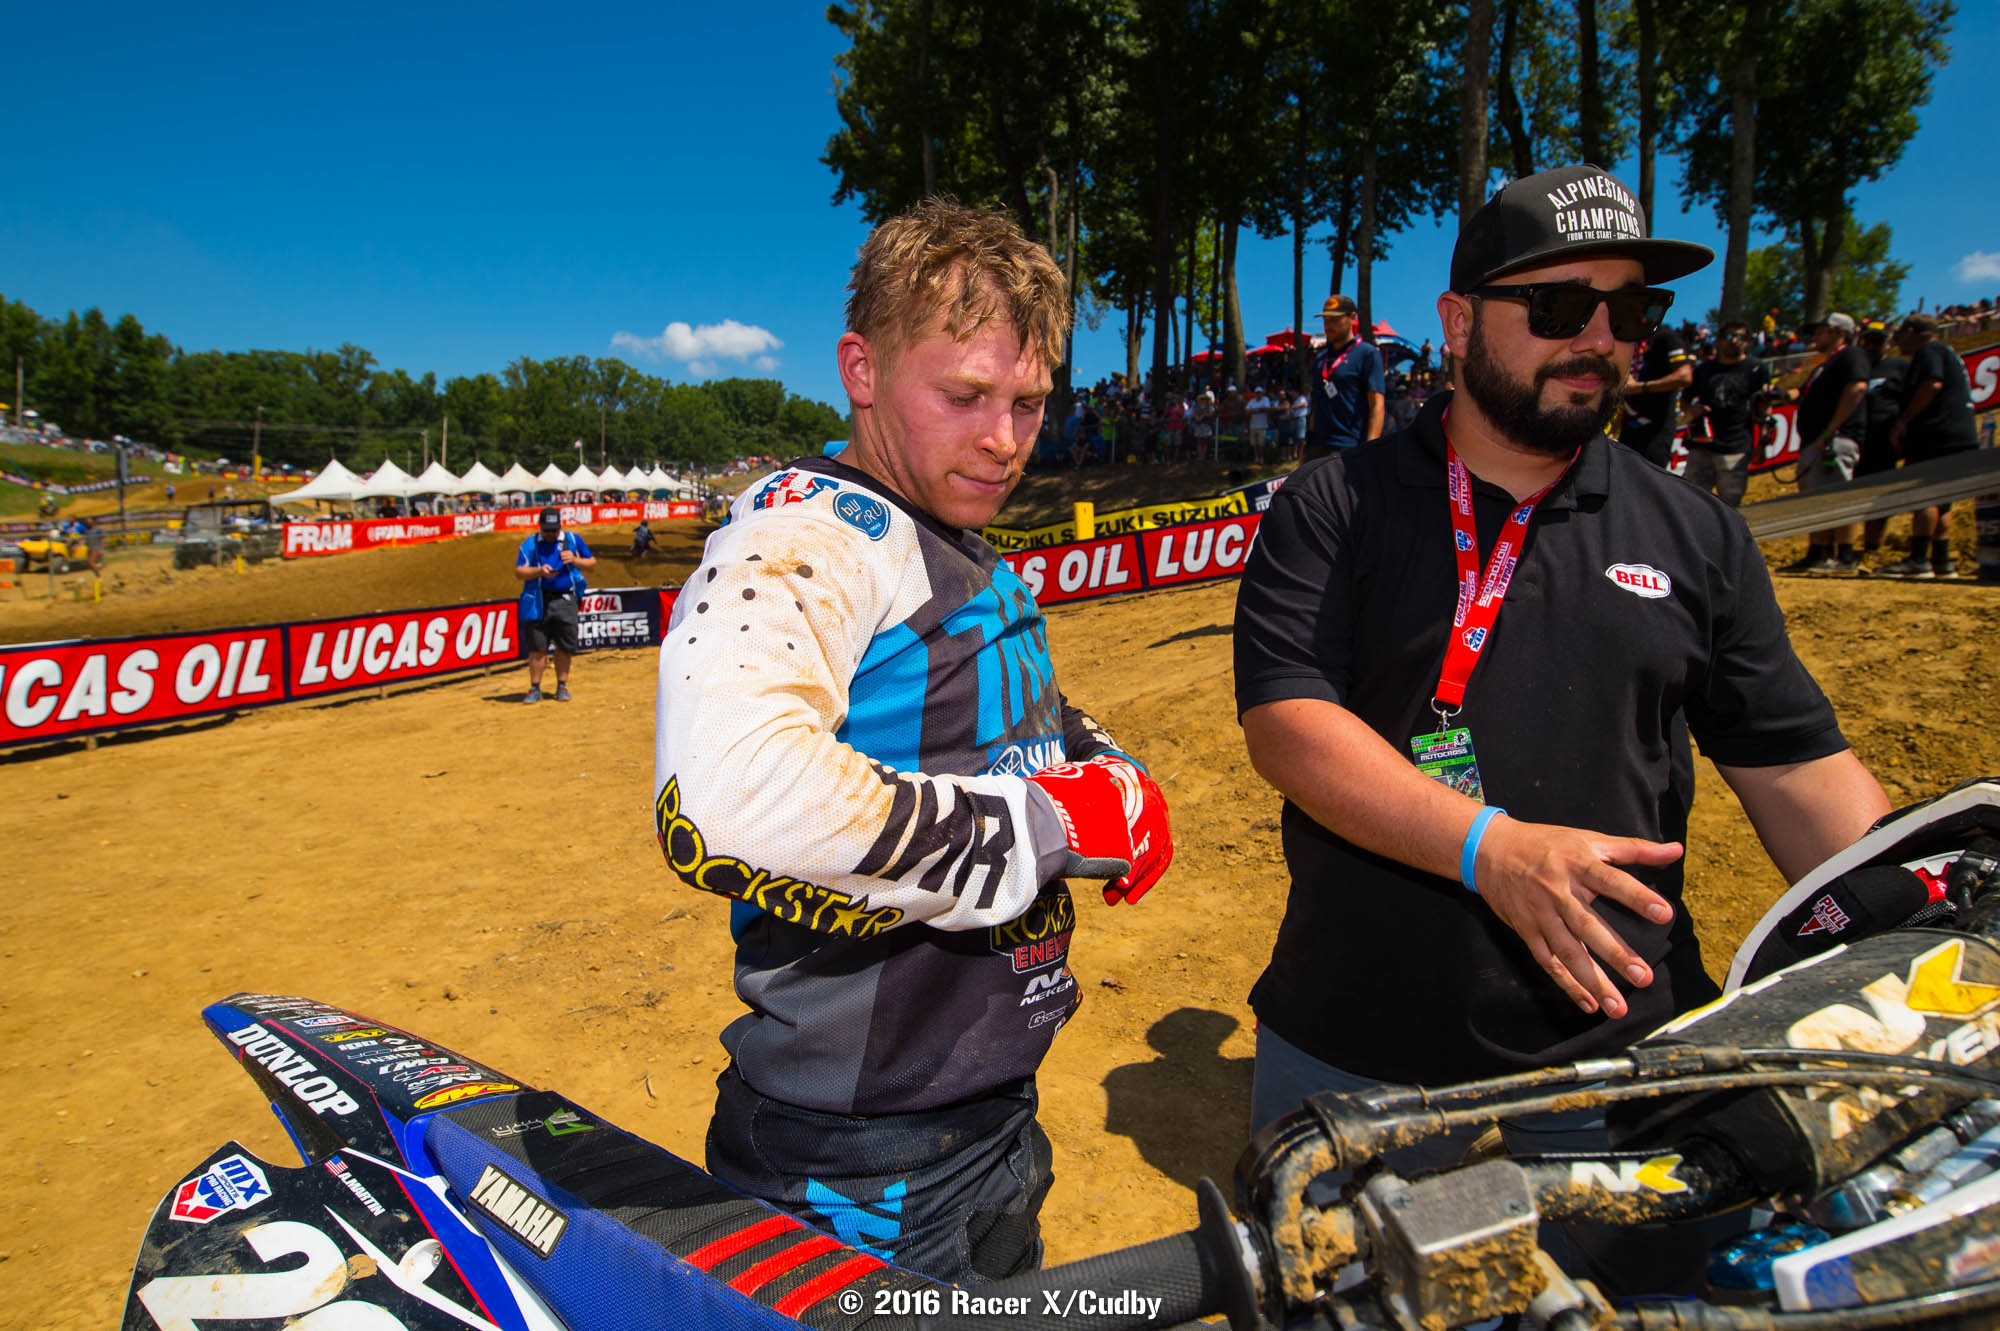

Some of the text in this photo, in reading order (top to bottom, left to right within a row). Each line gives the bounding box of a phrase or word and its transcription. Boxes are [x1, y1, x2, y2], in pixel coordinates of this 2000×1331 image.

[1547, 176, 1635, 214] ALPINESTARS
[1556, 208, 1640, 238] CHAMPIONS
[1567, 231, 1584, 241] FROM
[1584, 230, 1595, 240] THE
[1596, 230, 1612, 240] START
[287, 524, 352, 552] FRAM
[454, 514, 495, 536] FRAM
[986, 533, 1054, 549] SUZUKI
[1152, 501, 1242, 527] SUZUKI
[1058, 544, 1129, 593] OIL
[1155, 523, 1252, 578] LUC
[1479, 541, 1509, 607] MOTOCROSS
[1615, 569, 1663, 591] BELL
[594, 596, 618, 611] OIL
[300, 610, 510, 685] LUCAS OIL
[579, 636, 651, 647] IONSHIP
[0, 638, 271, 728] CAS OIL
[1421, 747, 1468, 761] MOTOCROSS
[1817, 894, 1850, 930] PULL
[1020, 978, 1073, 1007] NEKEN
[227, 1022, 359, 1118] DUNLOP
[205, 1174, 234, 1207] PRO RACING
[218, 1158, 268, 1203] MX
[218, 1174, 239, 1198] SPORTS
[470, 1165, 565, 1254] YAMAHA
